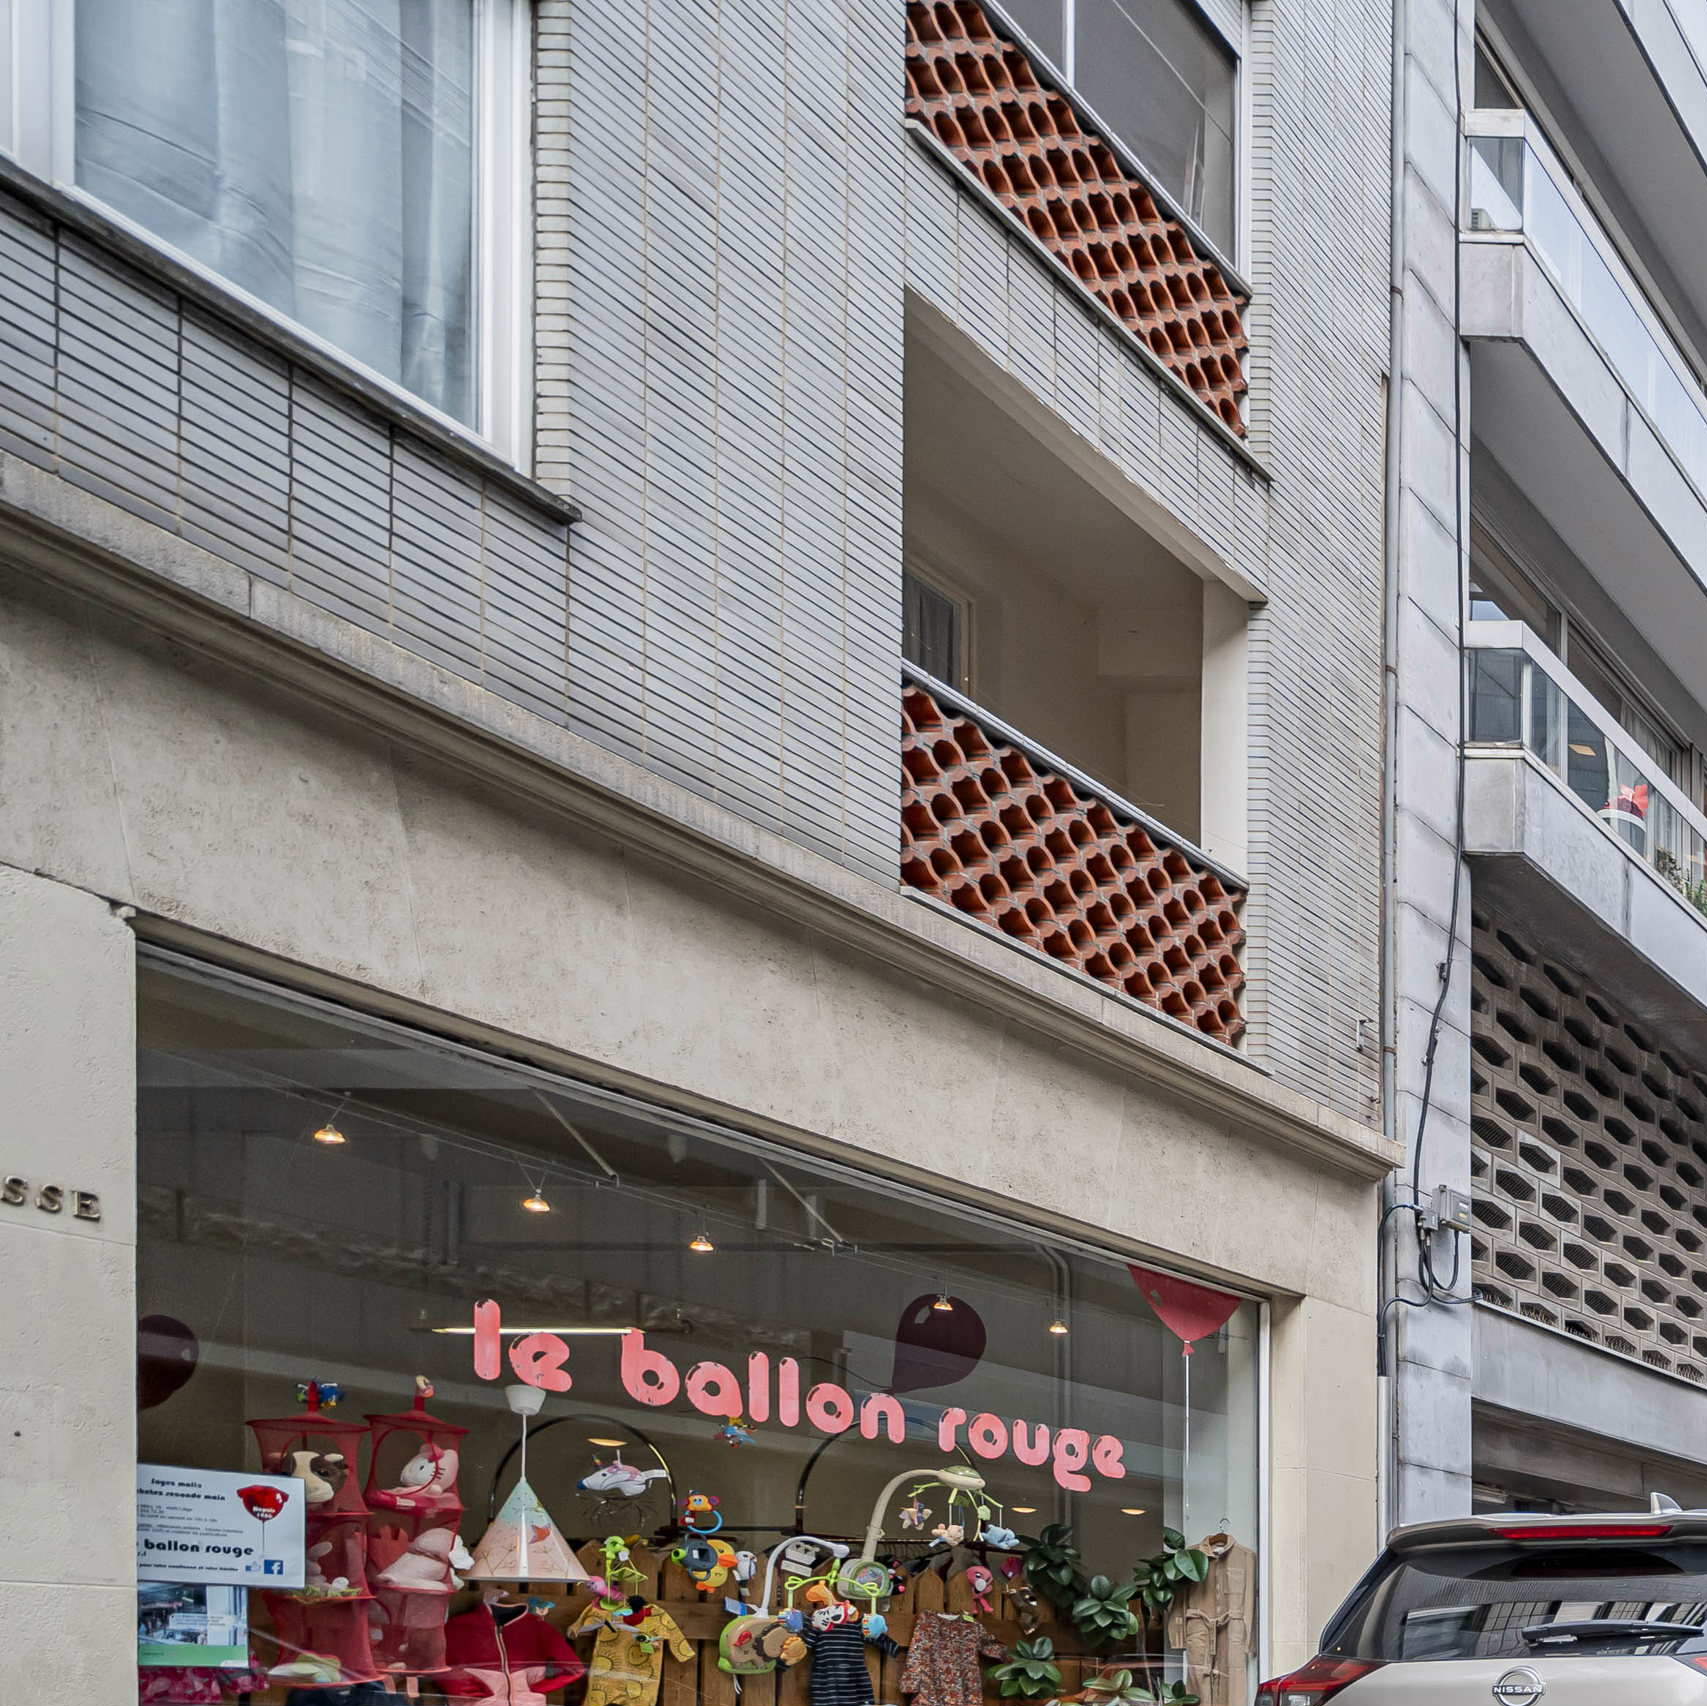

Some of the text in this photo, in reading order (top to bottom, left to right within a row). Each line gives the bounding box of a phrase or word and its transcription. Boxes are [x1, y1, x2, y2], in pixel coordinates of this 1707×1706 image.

[474, 1299, 1126, 1492] le ballon rouge
[144, 1538, 254, 1558] ballon rouge
[1493, 1685, 1543, 1694] NISSAN
